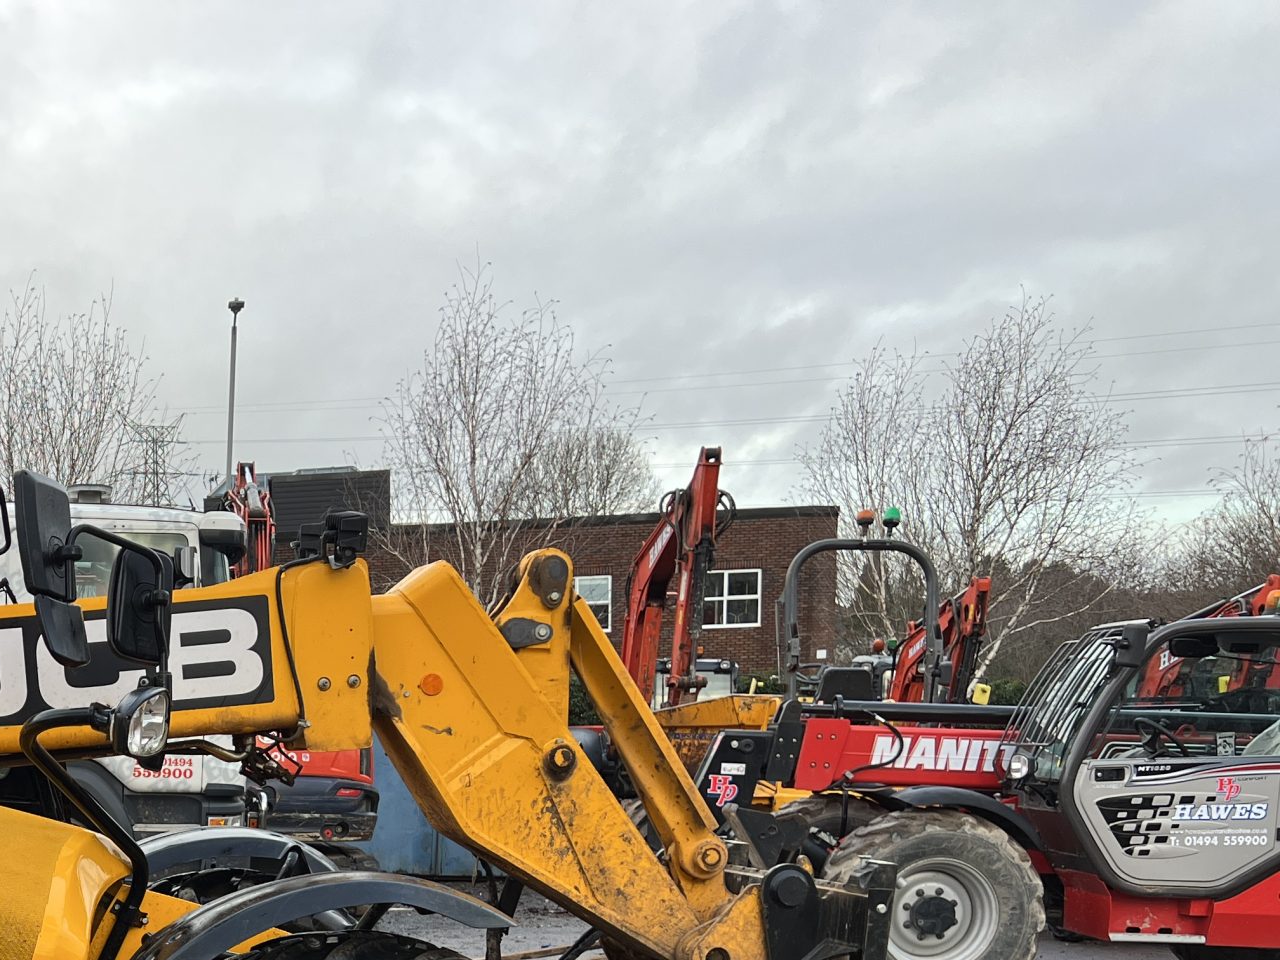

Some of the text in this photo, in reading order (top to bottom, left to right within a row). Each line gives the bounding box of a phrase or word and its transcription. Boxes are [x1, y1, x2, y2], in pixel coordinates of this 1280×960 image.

[1171, 803, 1268, 821] HAWES
[1184, 836, 1219, 846] 01494
[1223, 835, 1268, 846] 559900
